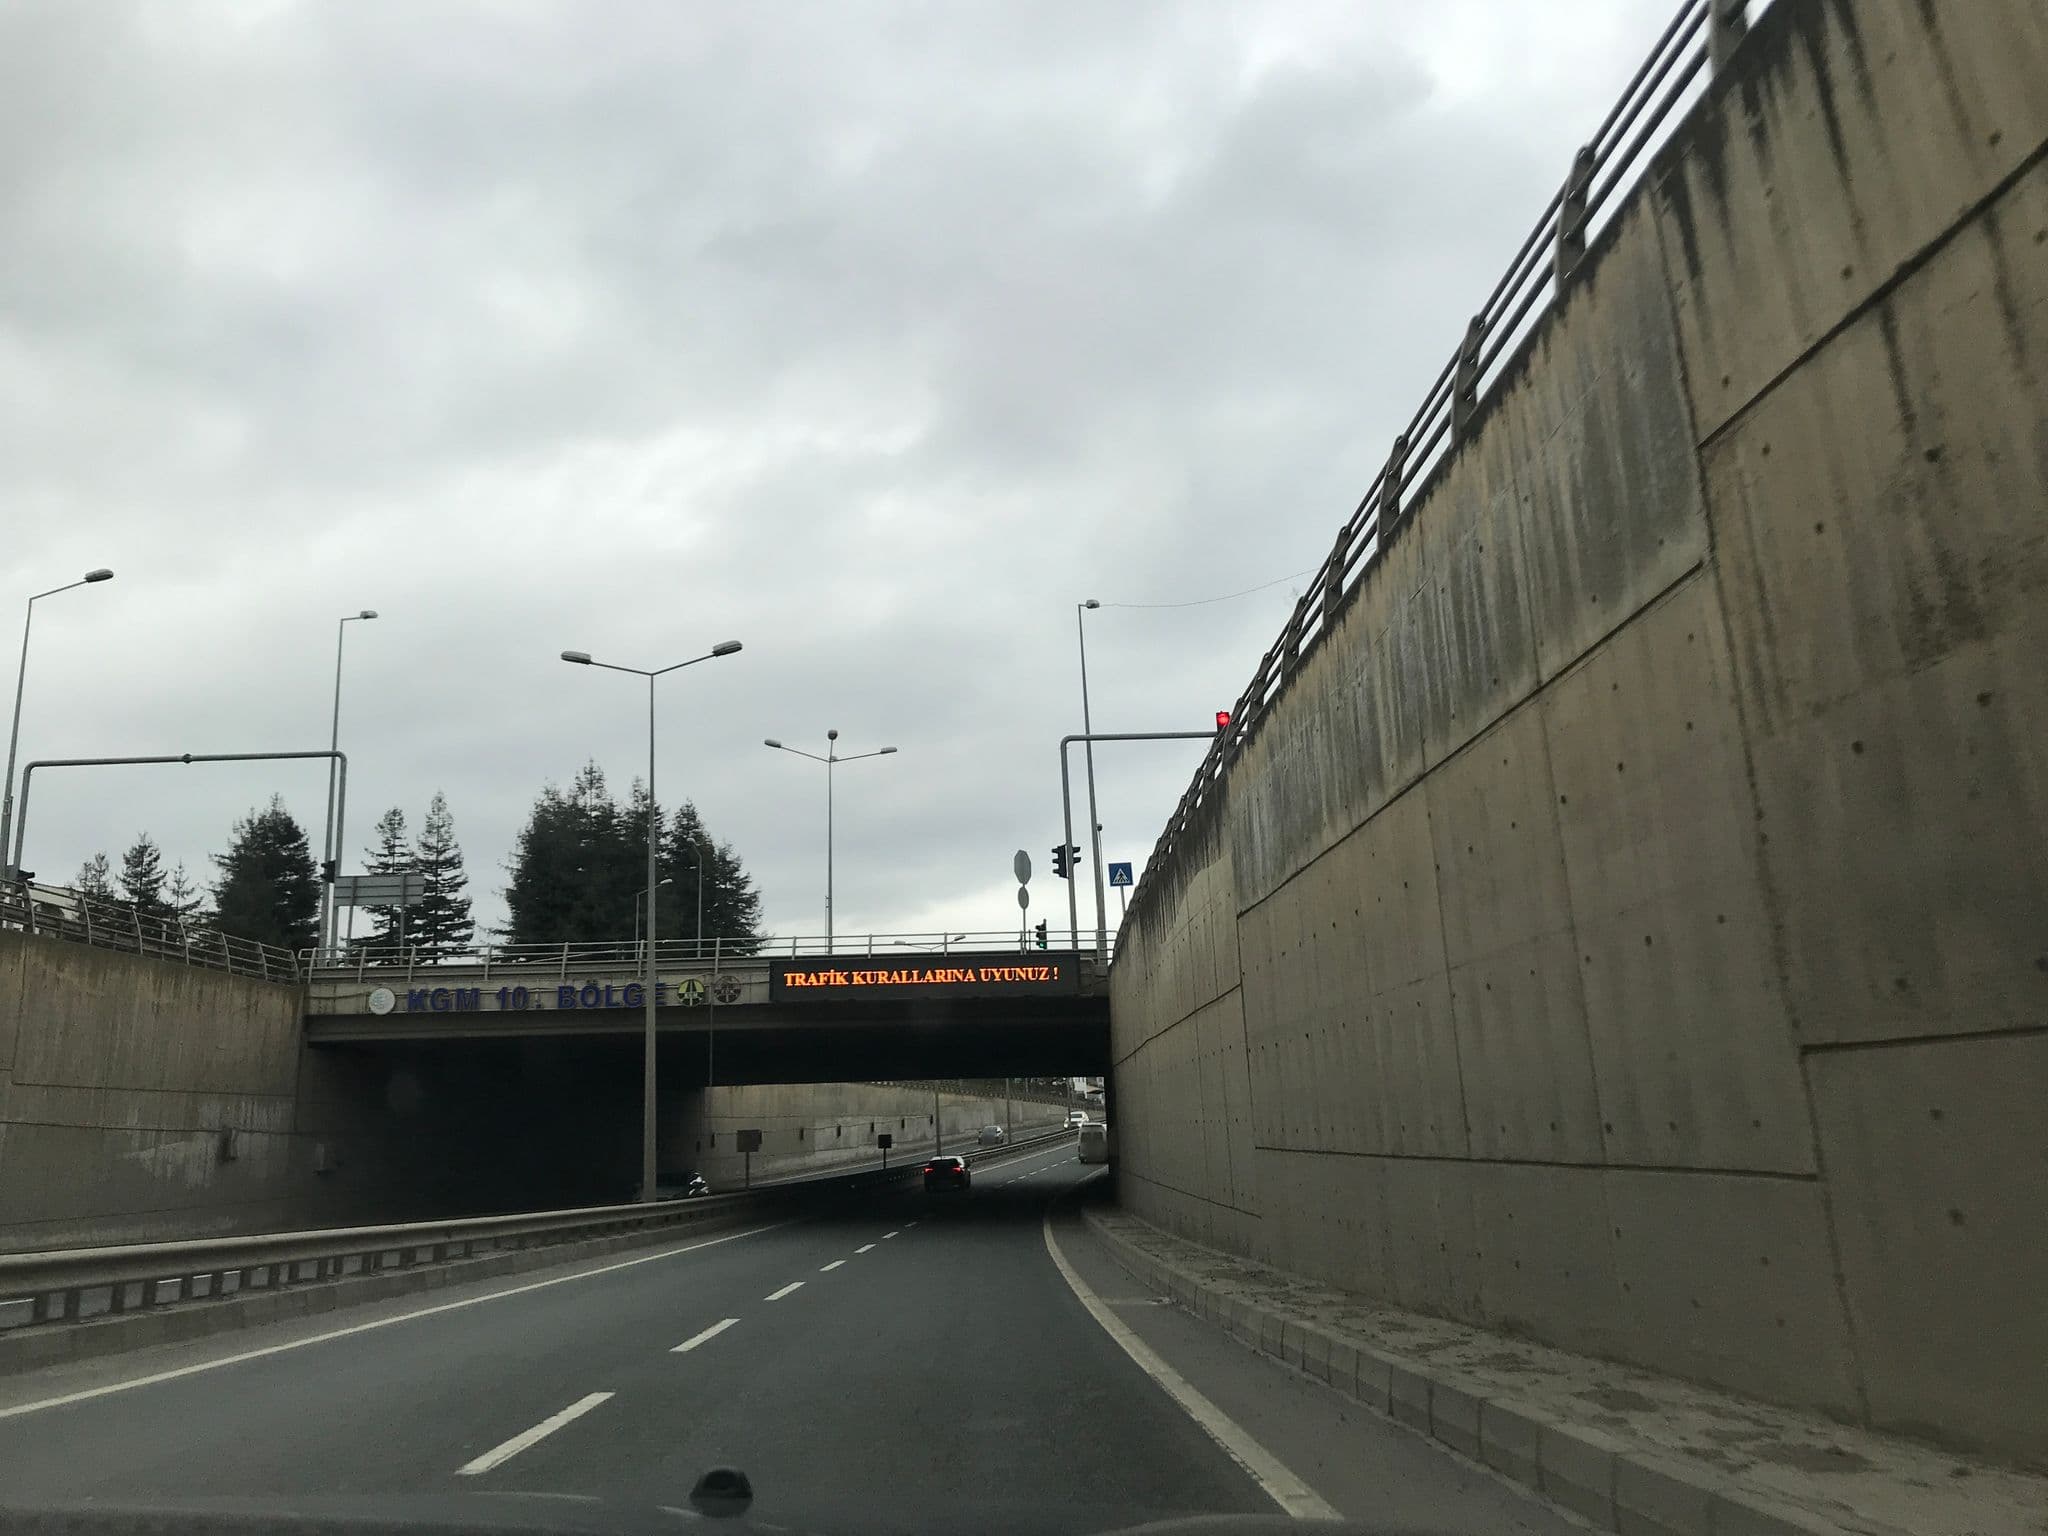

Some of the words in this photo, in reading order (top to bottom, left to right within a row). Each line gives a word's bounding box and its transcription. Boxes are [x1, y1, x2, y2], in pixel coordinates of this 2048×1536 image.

[784, 968, 849, 986] TRAFİK
[851, 968, 977, 985] KURALLARINA
[407, 988, 481, 1011] KGM
[557, 979, 667, 1009] BÖLGE
